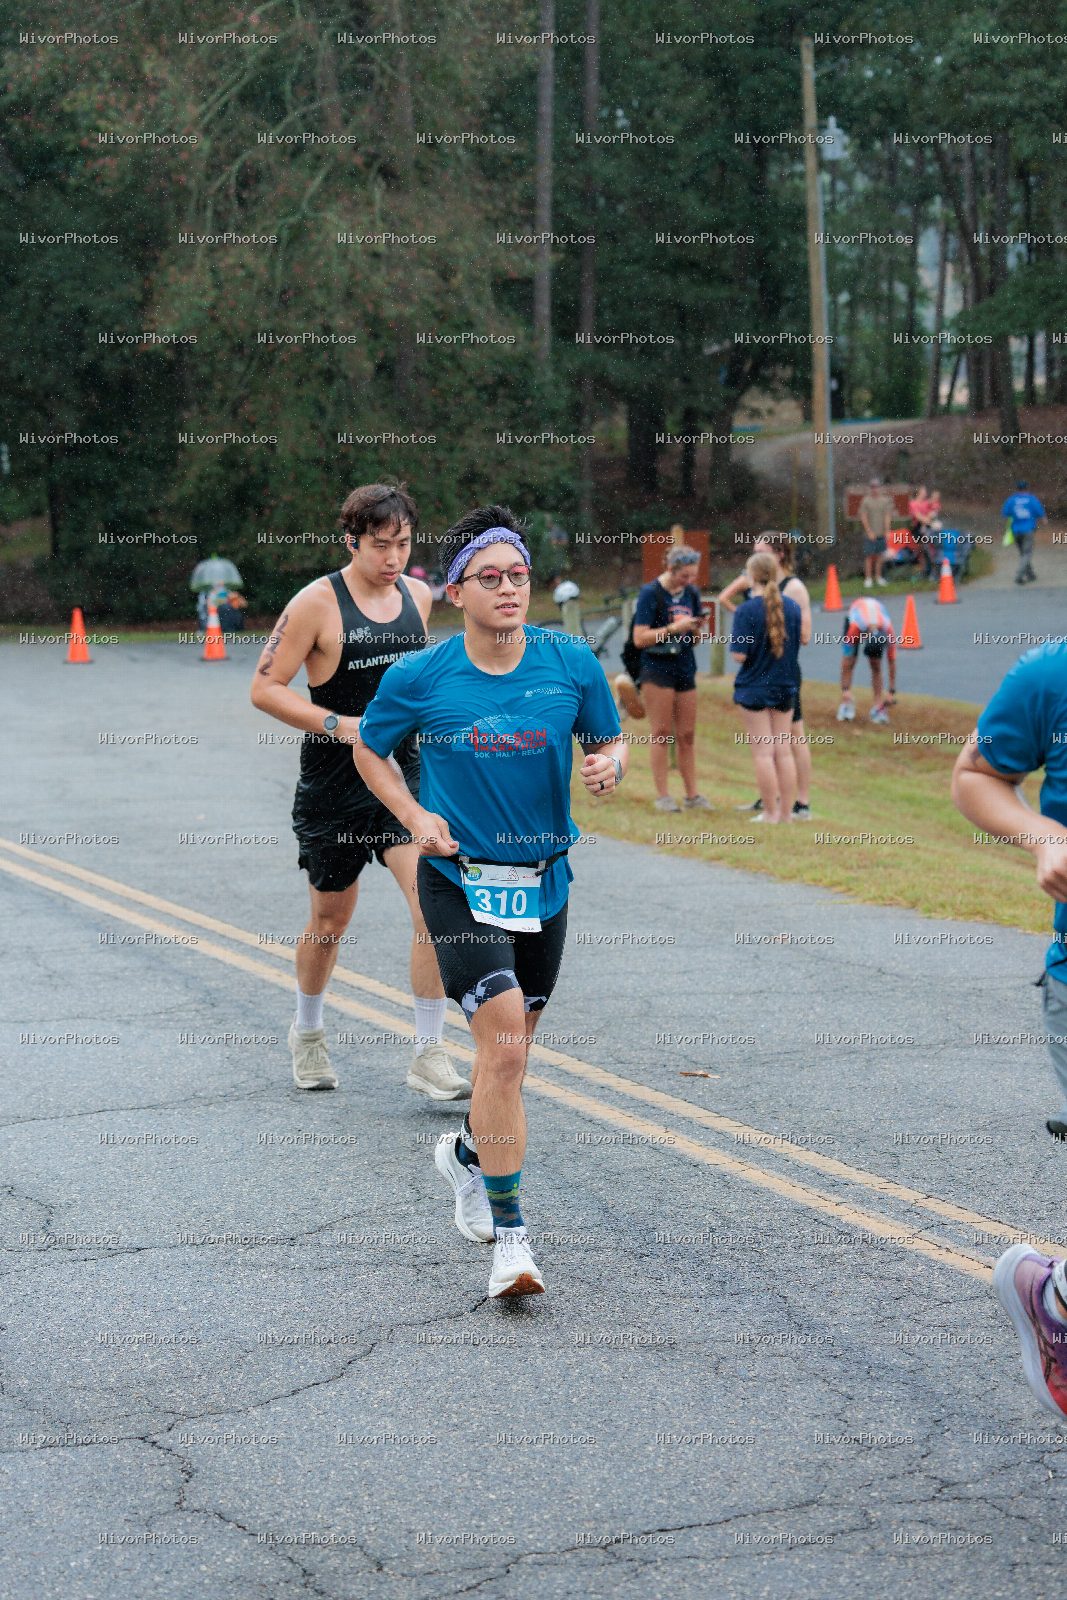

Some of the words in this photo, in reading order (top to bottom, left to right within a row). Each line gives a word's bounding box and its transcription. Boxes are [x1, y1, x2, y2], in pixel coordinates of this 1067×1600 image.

[474, 751, 490, 759] 50K
[521, 747, 546, 757] RELAY
[475, 888, 527, 916] 310
